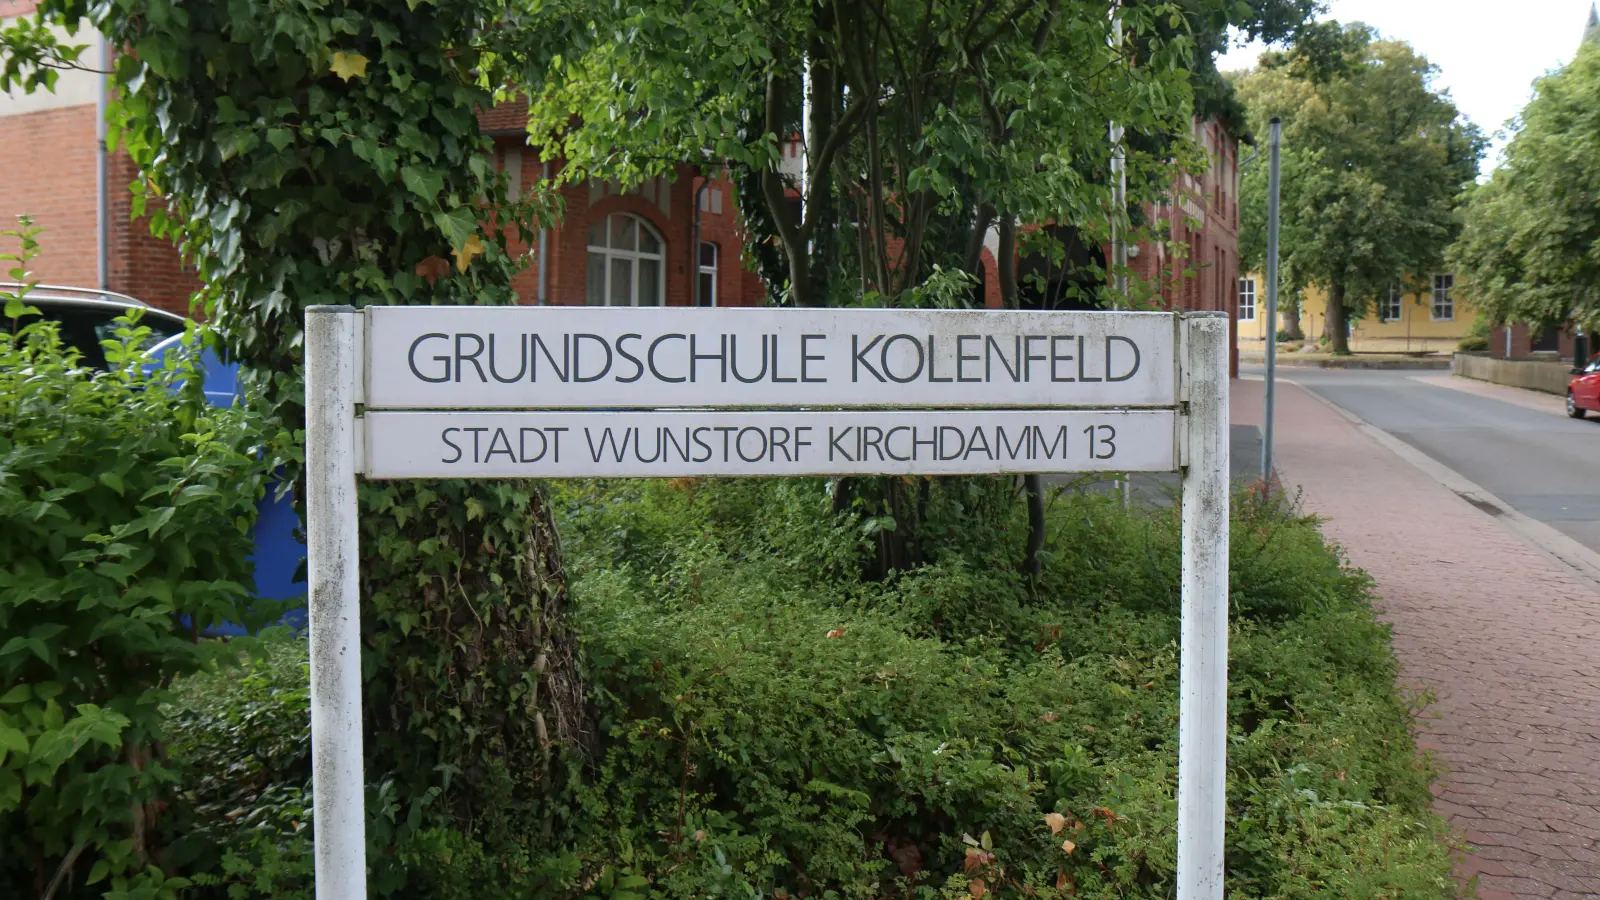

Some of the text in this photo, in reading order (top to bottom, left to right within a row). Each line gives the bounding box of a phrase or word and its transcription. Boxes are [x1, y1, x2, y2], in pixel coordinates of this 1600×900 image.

[408, 332, 1141, 384] GRUNDSCHULE KOLENFELD
[441, 424, 1118, 464] STADT WUNSTORF KIRCHDAMM 13
